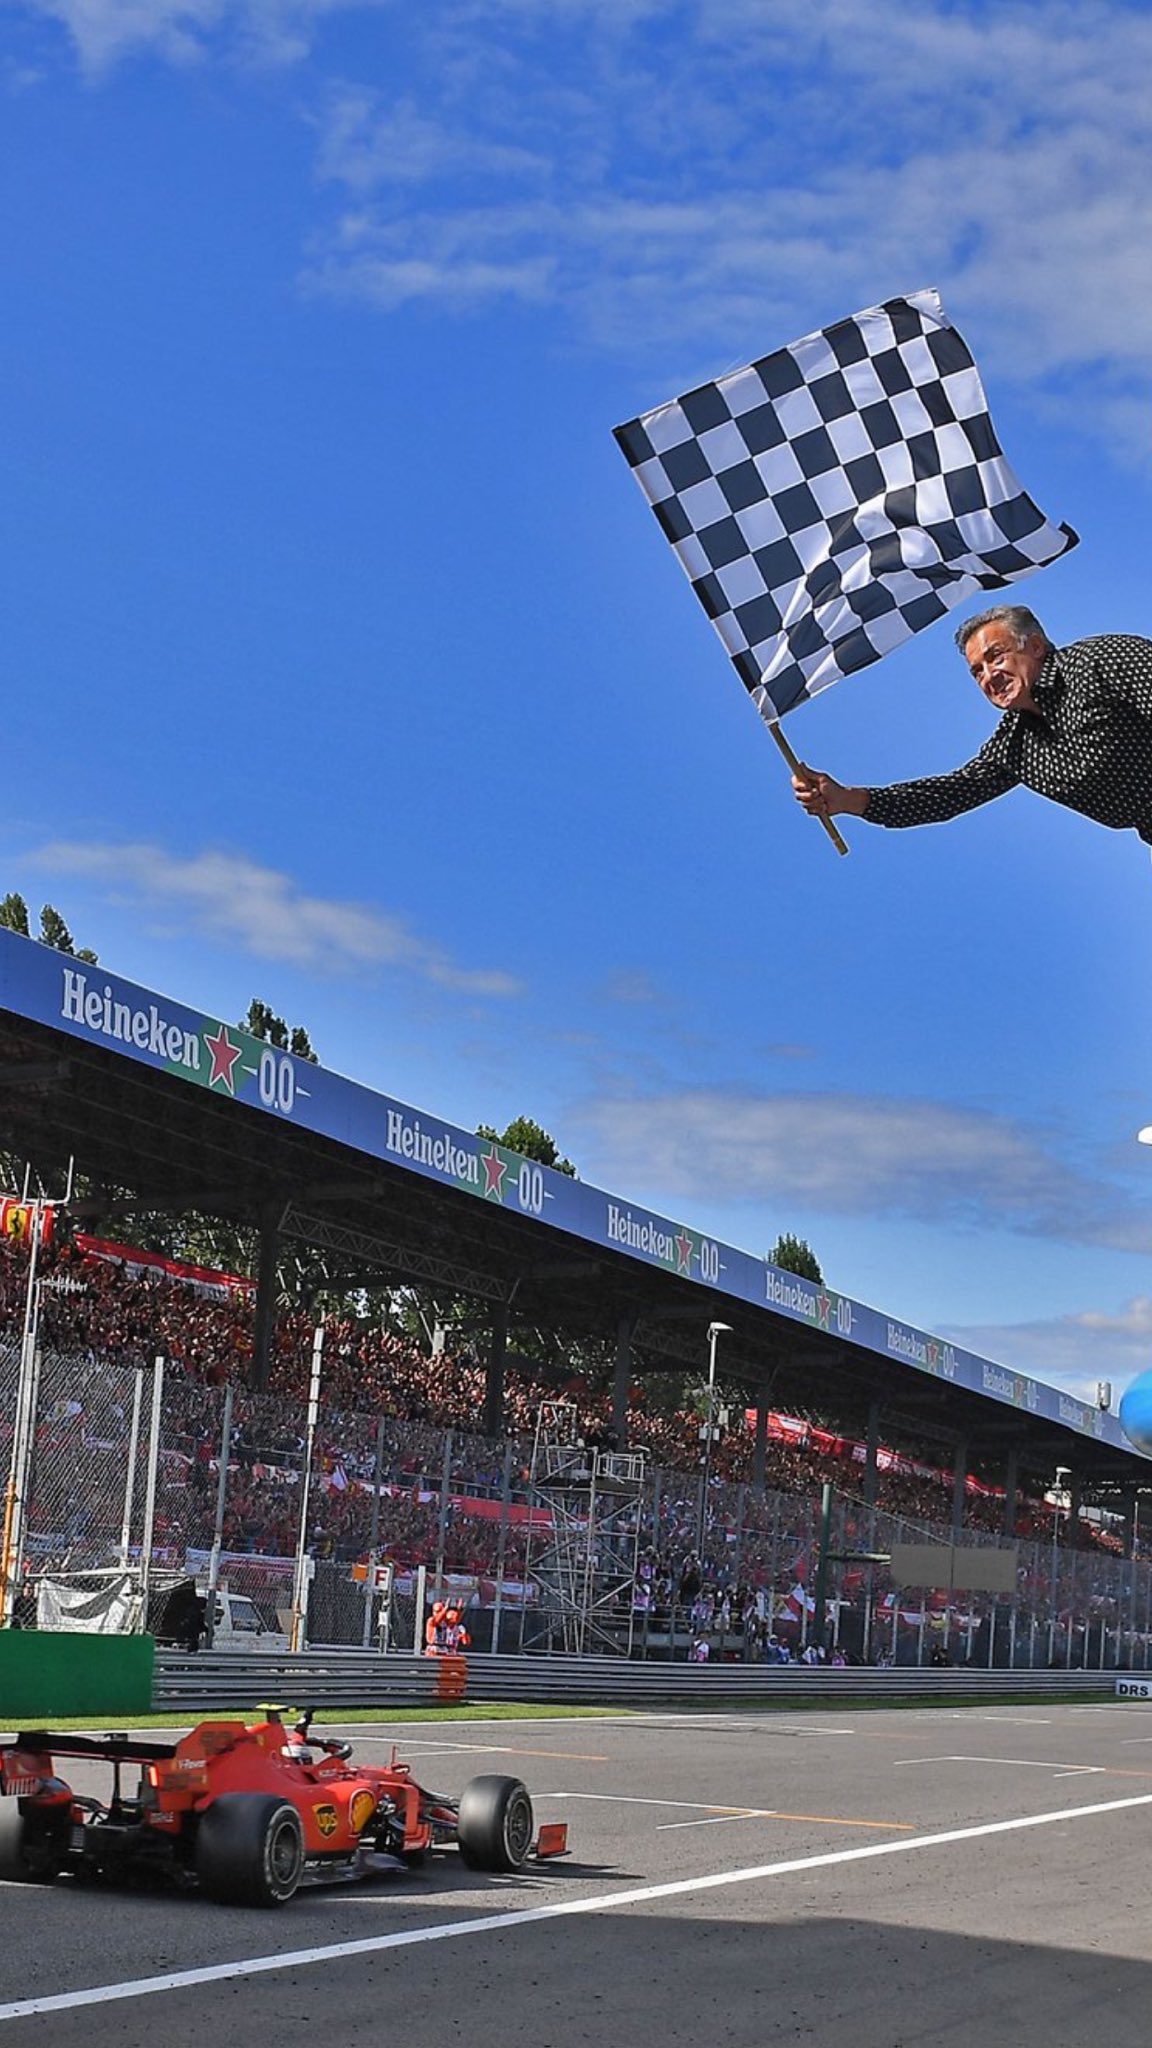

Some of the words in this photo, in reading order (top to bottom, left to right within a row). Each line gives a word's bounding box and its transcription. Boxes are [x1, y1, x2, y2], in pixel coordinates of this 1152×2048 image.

[62, 967, 200, 1070] Heineken
[258, 1048, 295, 1115] 0.0
[386, 1109, 480, 1185] Heineken
[518, 1161, 544, 1215] 0.0
[607, 1204, 674, 1262] Heineken
[701, 1238, 719, 1284] 0.0
[766, 1270, 816, 1318] Heineken
[375, 1569, 388, 1586] F
[1119, 1684, 1149, 1697] DRS
